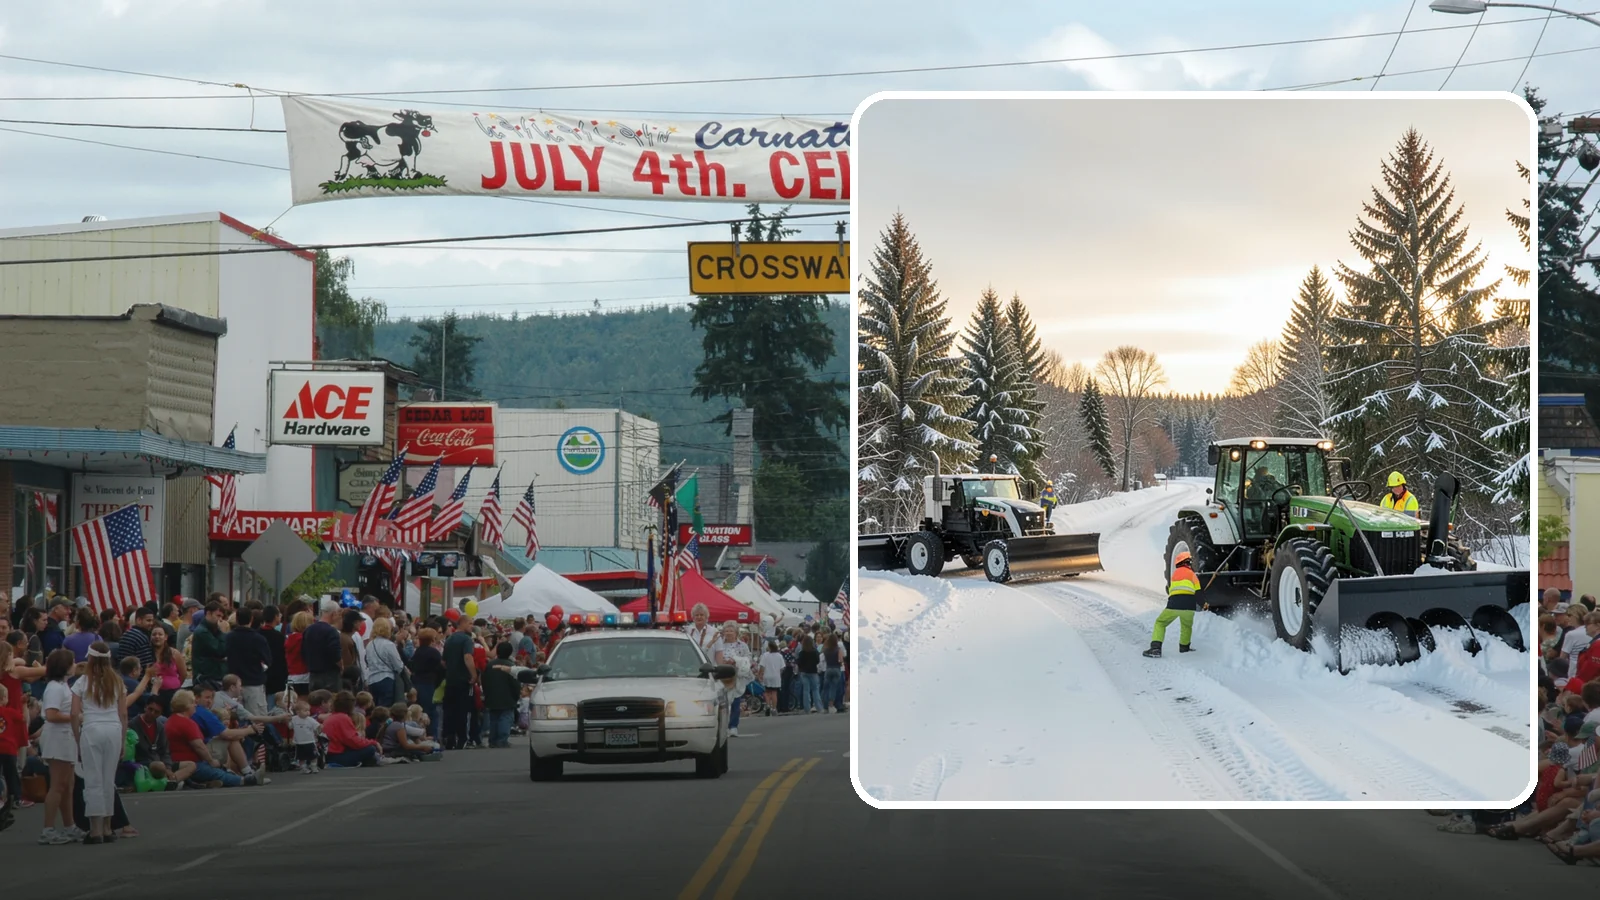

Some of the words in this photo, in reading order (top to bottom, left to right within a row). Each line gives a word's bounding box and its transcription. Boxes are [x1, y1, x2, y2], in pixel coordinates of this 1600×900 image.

[695, 121, 850, 150] Carnat
[481, 141, 604, 192] JULY
[632, 150, 747, 197] 4th.
[697, 254, 850, 280] CROSSWA
[282, 380, 373, 420] ACE
[405, 409, 452, 421] CEDAR
[283, 421, 371, 436] Hardware
[416, 428, 477, 447] Coca-Cola
[96, 485, 125, 494] Vincent
[126, 485, 136, 494] de
[138, 486, 155, 495] Paul
[688, 526, 742, 535] CRNATION
[699, 535, 731, 543] GLASS
